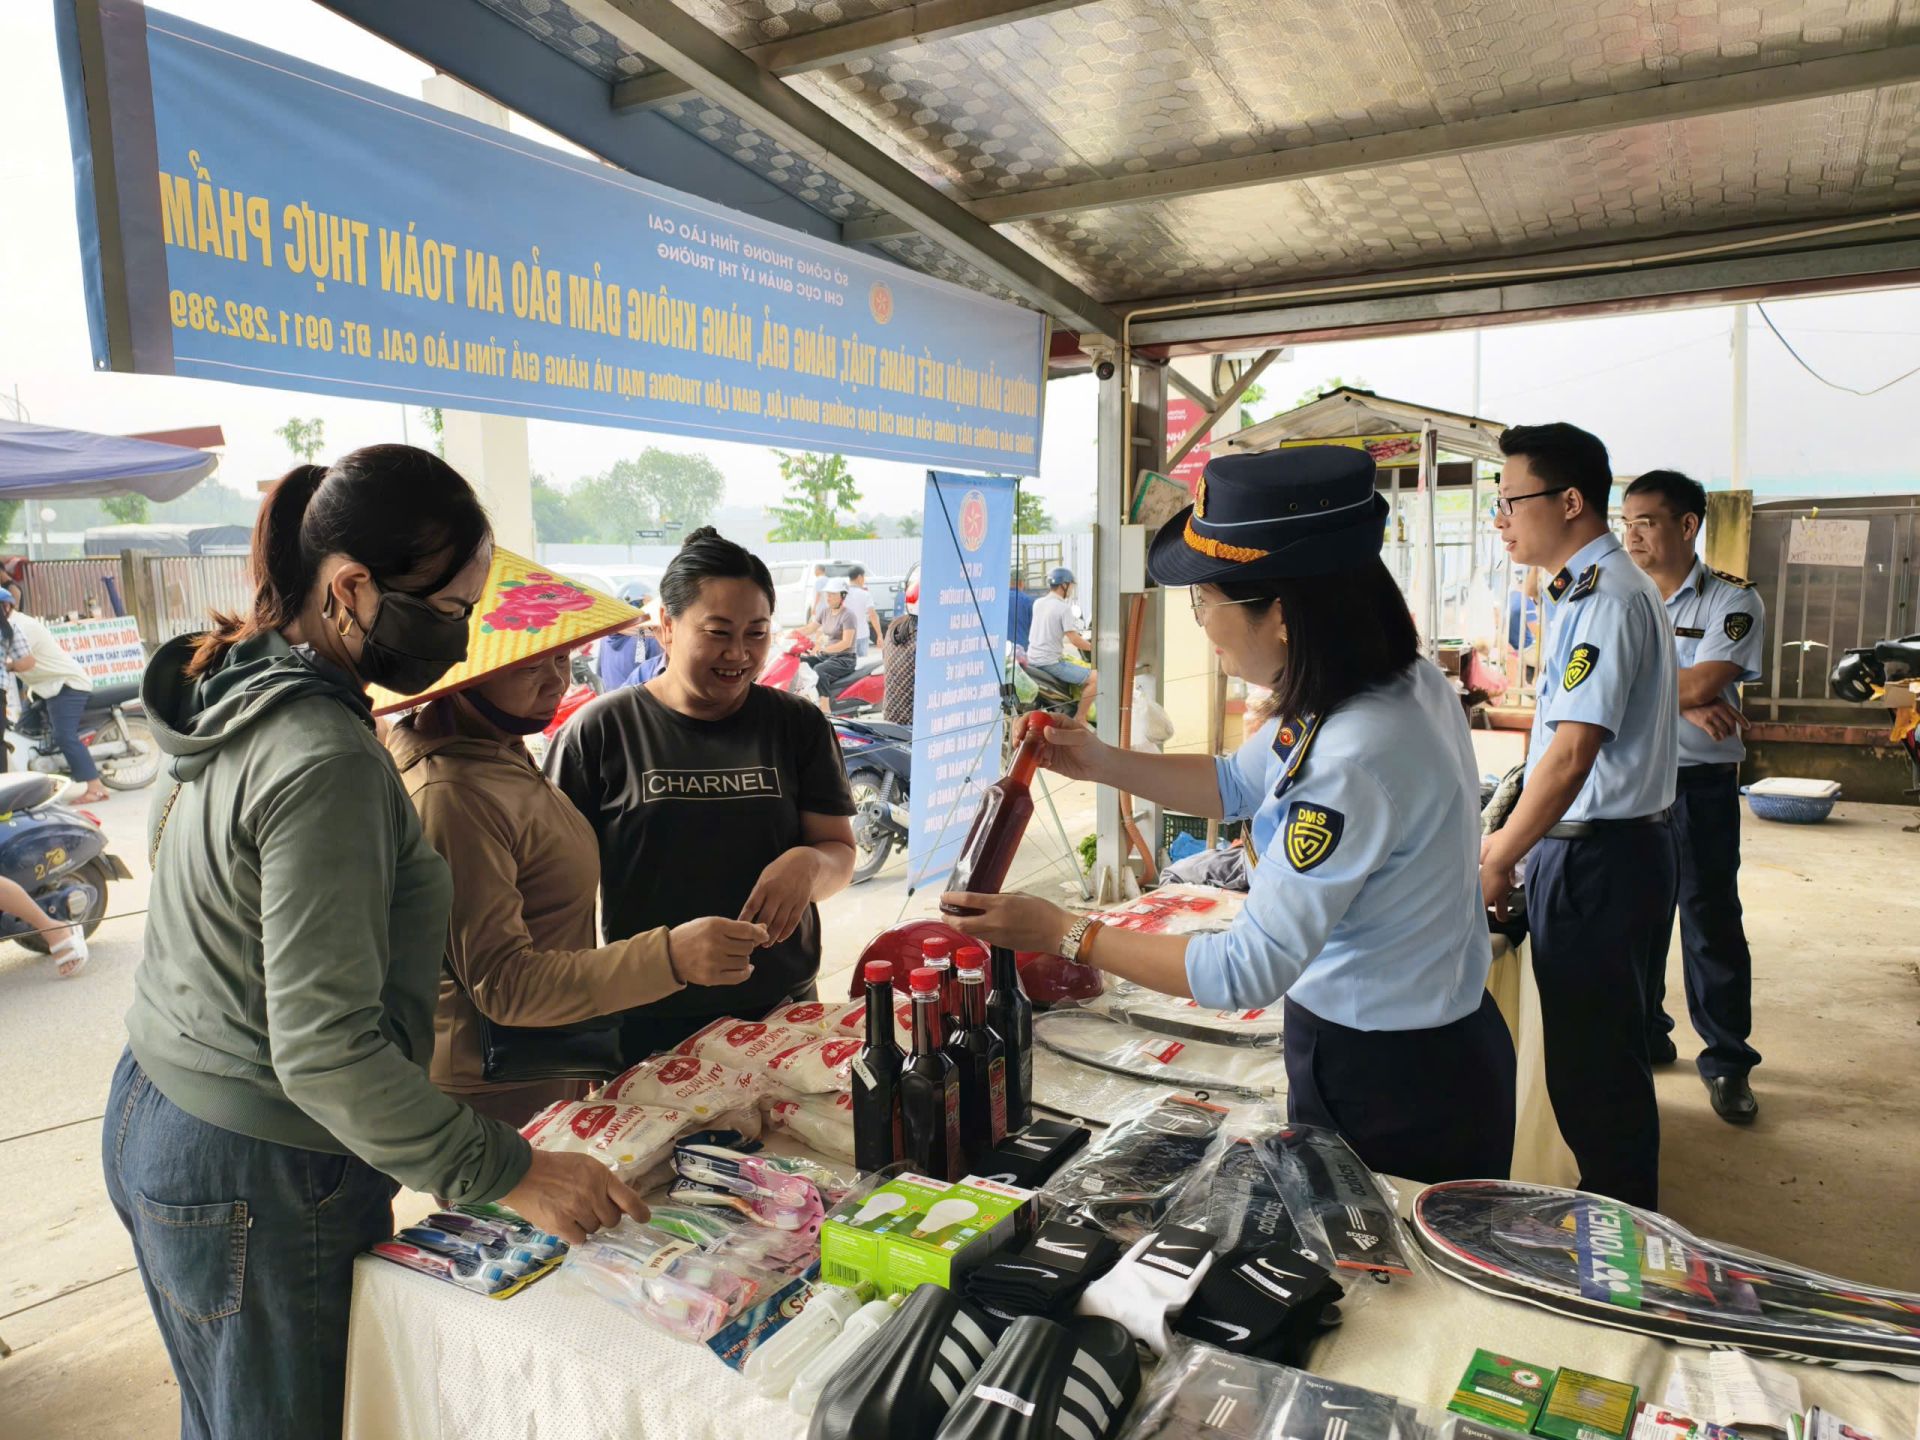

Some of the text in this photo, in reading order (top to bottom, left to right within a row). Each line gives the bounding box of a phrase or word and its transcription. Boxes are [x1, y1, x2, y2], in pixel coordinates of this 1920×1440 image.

[648, 772, 774, 794] CHARNEL
[1297, 808, 1328, 826] DMS
[1257, 1200, 1283, 1235] adidas
[1346, 1231, 1380, 1243] adidas
[1588, 1203, 1625, 1258] YONEX
[1210, 1357, 1237, 1370] Sports
[1305, 1380, 1335, 1392] Sports
[1461, 1425, 1494, 1440] Sports
